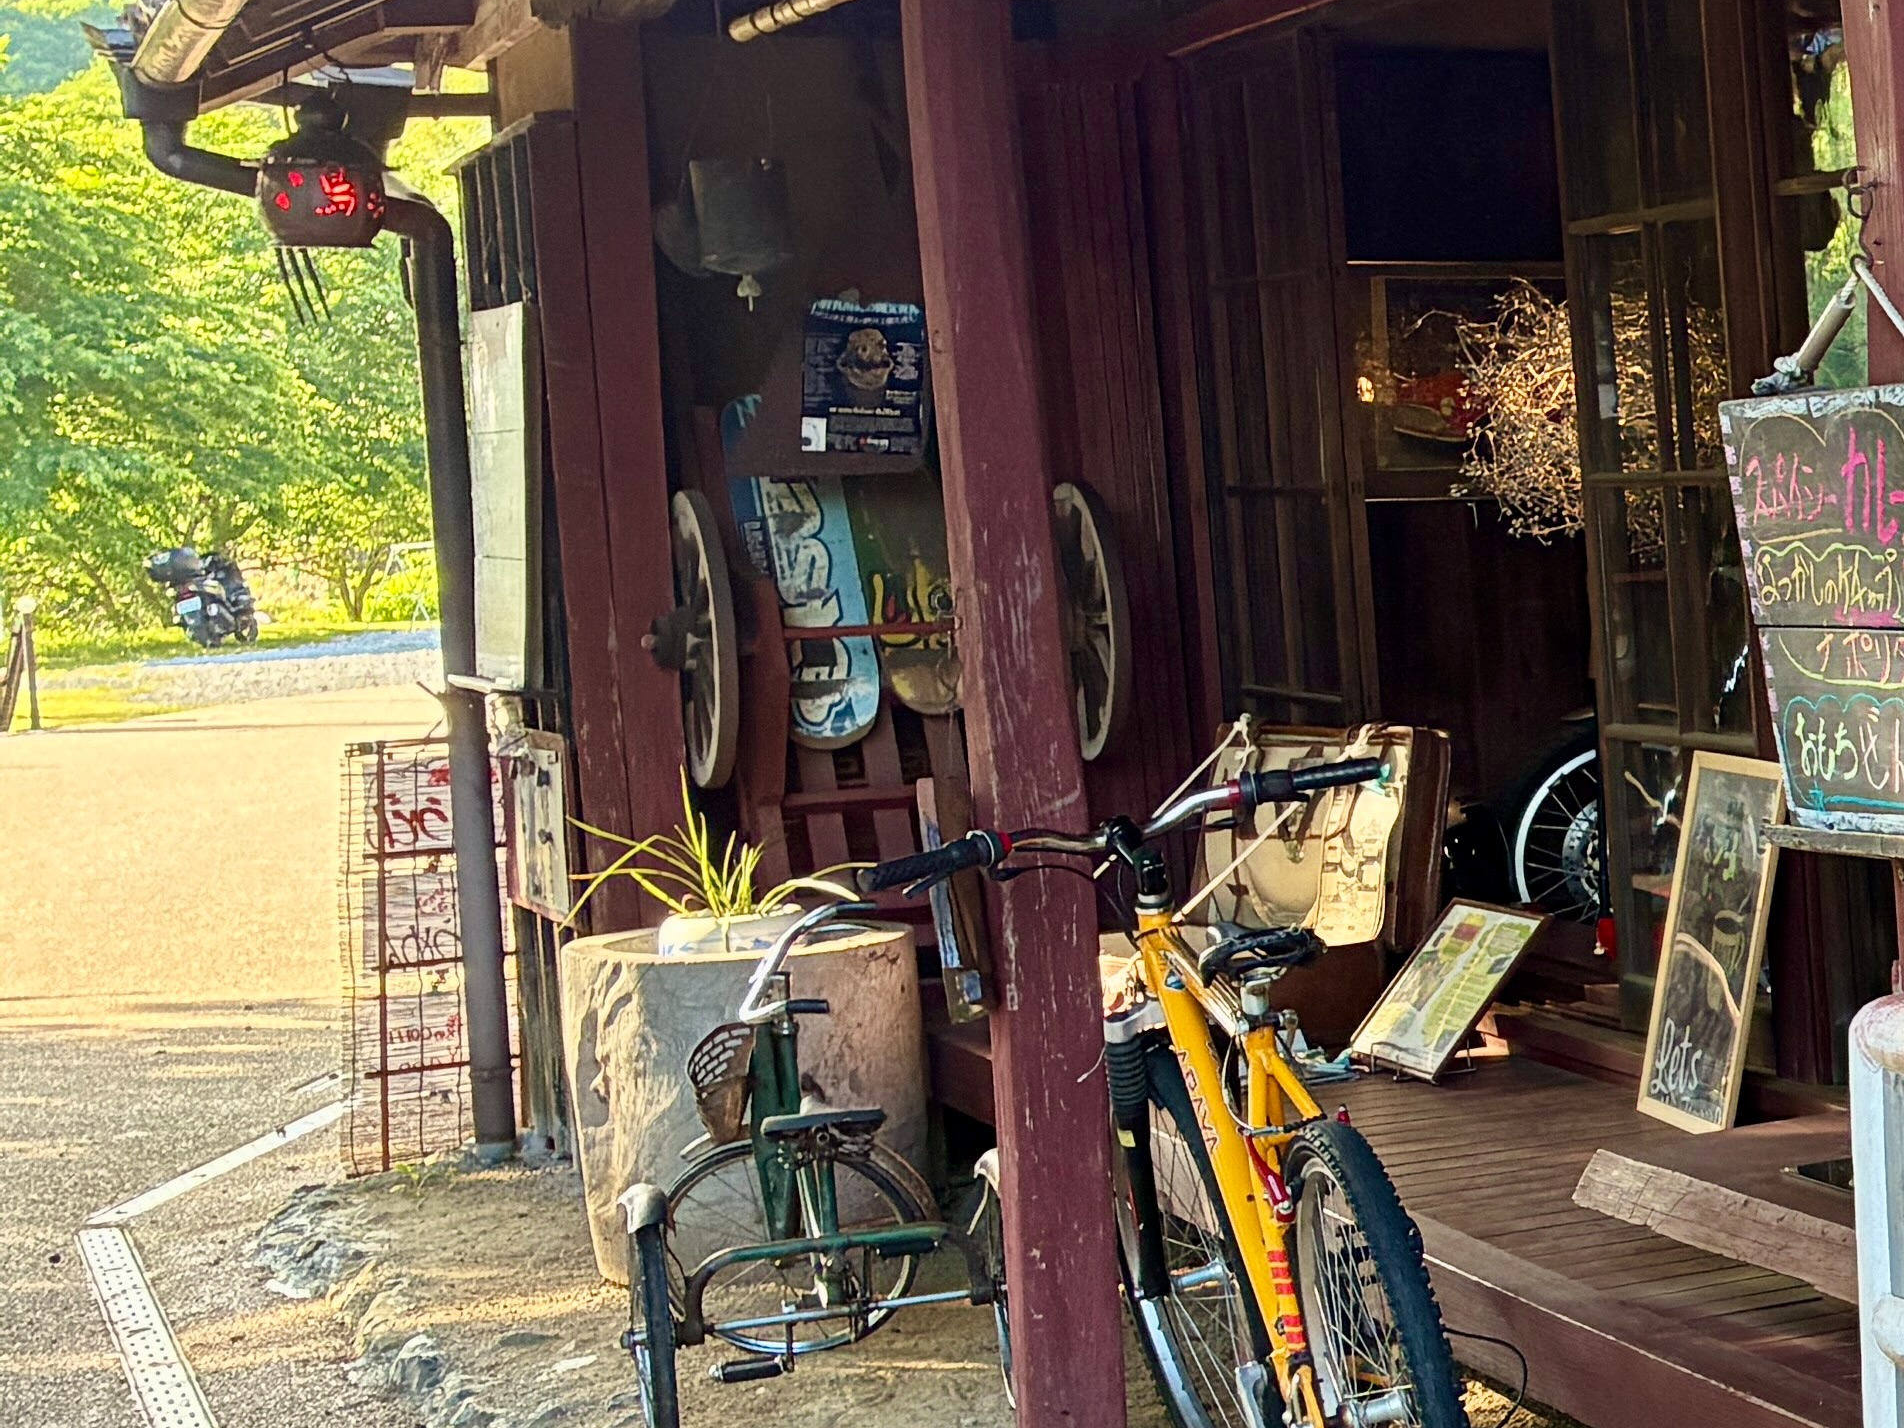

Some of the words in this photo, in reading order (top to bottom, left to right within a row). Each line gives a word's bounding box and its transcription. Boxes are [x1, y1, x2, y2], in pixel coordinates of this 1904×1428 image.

[1746, 452, 1838, 526] スパイシー
